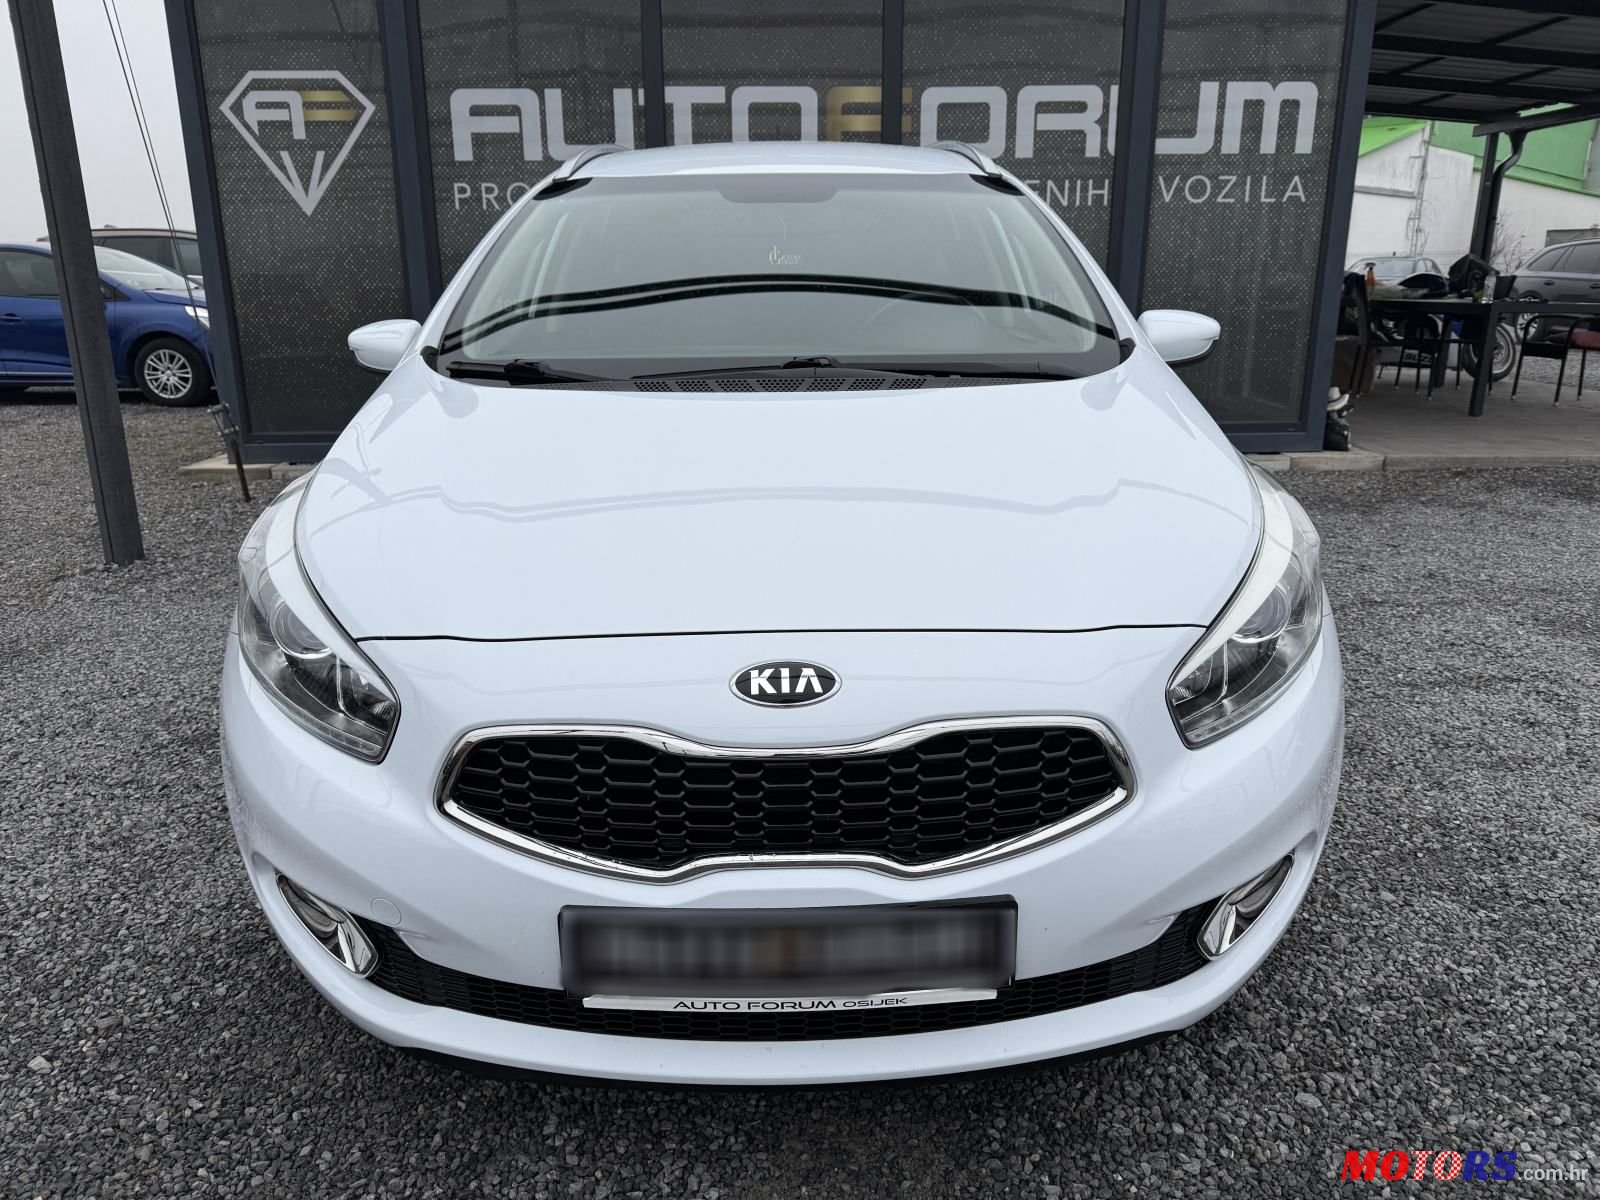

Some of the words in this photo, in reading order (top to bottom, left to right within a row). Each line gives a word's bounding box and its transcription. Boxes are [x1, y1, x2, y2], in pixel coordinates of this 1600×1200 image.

[1158, 175, 1306, 203] VOZILA
[749, 667, 824, 695] KIA
[673, 1000, 741, 1010] AUTO
[747, 1000, 837, 1010] FORUM
[842, 997, 908, 1008] OSIJEK
